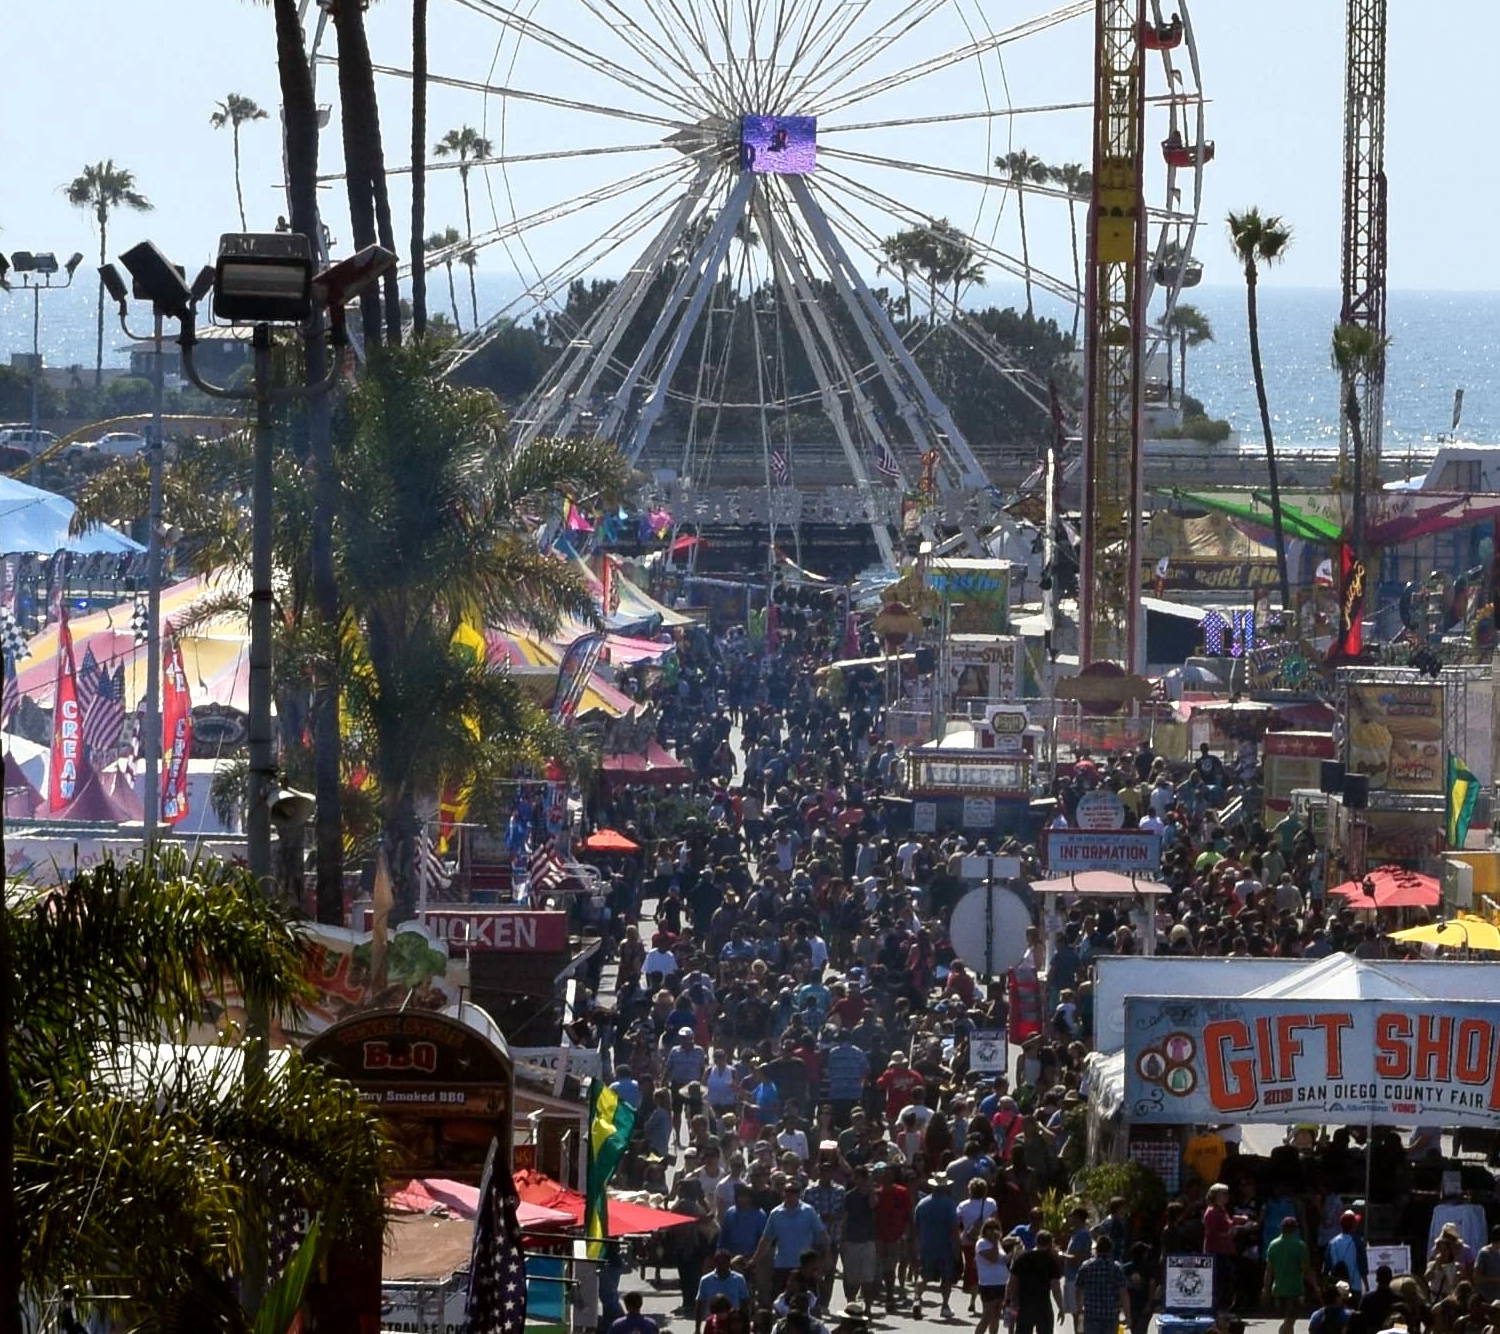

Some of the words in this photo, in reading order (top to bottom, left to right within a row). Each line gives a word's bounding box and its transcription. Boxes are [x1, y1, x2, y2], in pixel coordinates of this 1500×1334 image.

[58, 700, 82, 800] CREAM
[1059, 844, 1148, 862] INFORMATION
[363, 1040, 436, 1073] BBQ
[1202, 1013, 1353, 1114] GIFT
[386, 1090, 435, 1103] Smoked
[439, 1091, 465, 1104] BBQ
[1297, 1086, 1326, 1101] SAN
[1334, 1084, 1377, 1099] DIEGO
[1384, 1084, 1443, 1102] COUNTY
[1450, 1090, 1483, 1108] FAIR
